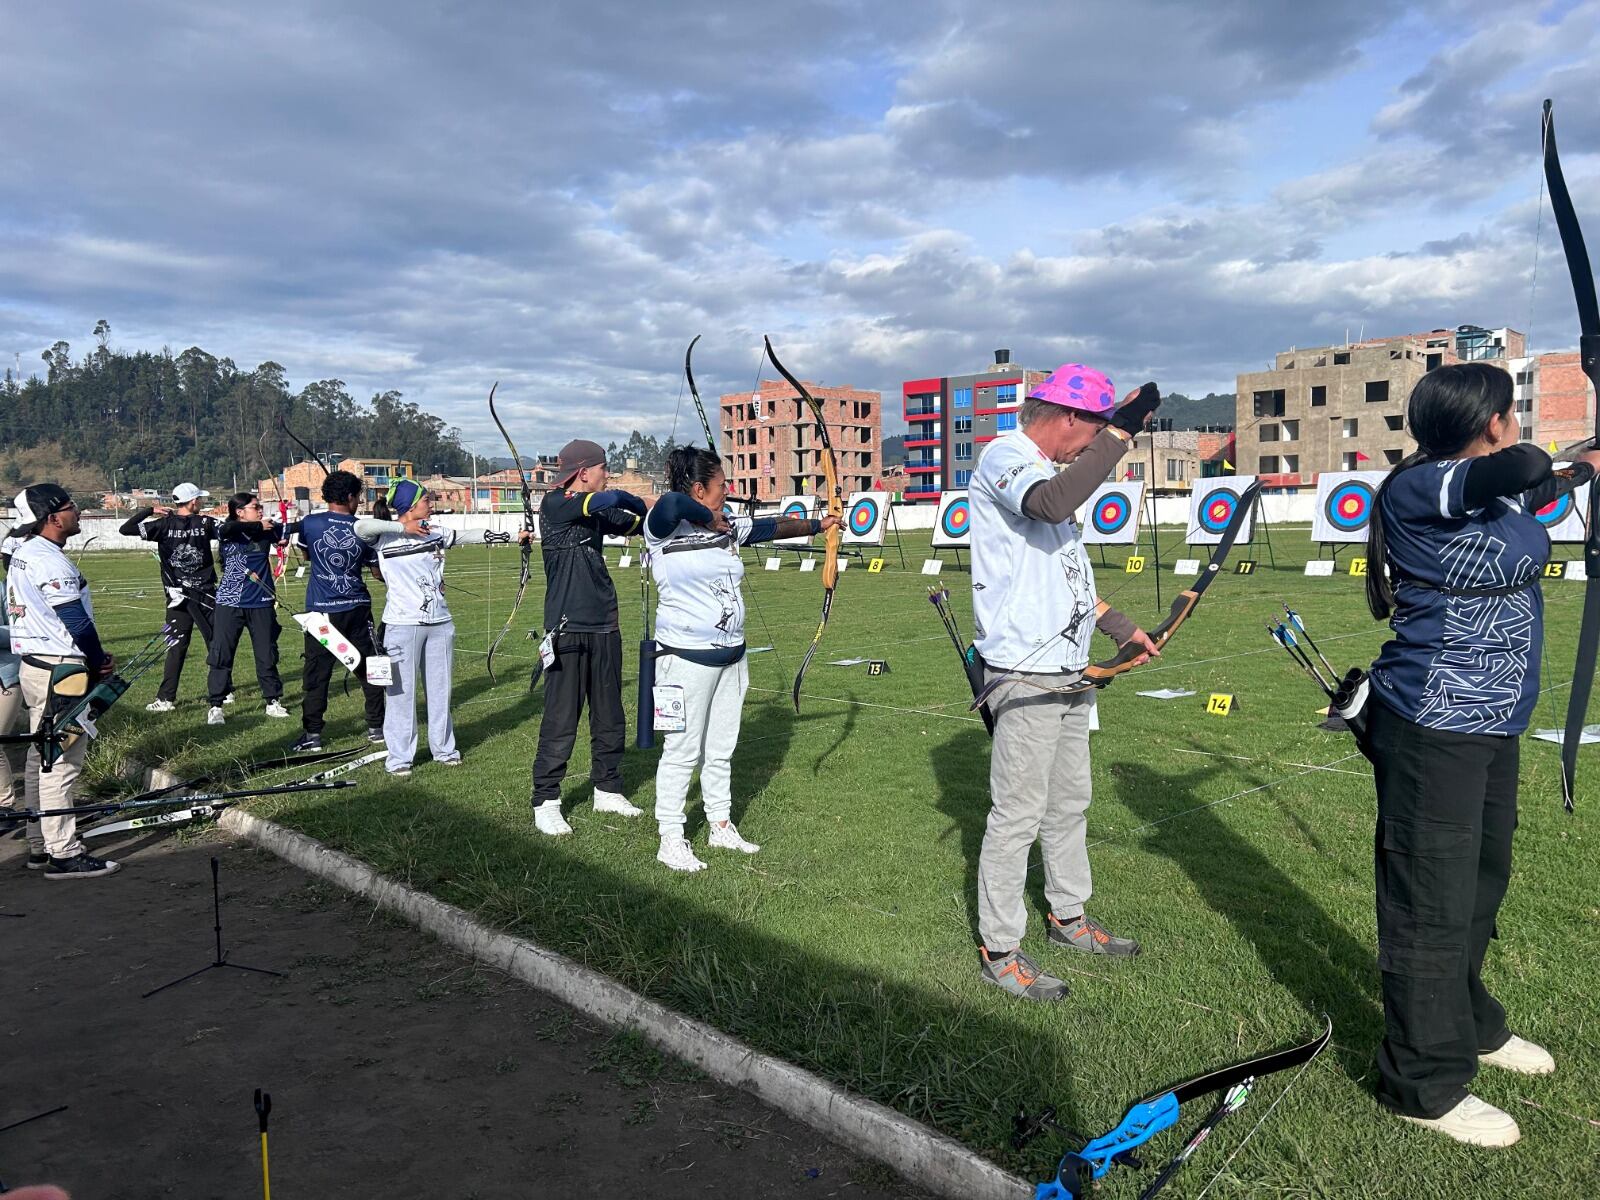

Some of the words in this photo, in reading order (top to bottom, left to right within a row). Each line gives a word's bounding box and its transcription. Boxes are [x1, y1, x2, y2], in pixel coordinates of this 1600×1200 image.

[872, 560, 879, 570] 8
[1129, 559, 1142, 570] 10
[1239, 562, 1252, 574] 11
[1354, 561, 1367, 573] 12
[1544, 563, 1564, 577] 13
[870, 663, 881, 675] 13
[1212, 698, 1226, 711] 14
